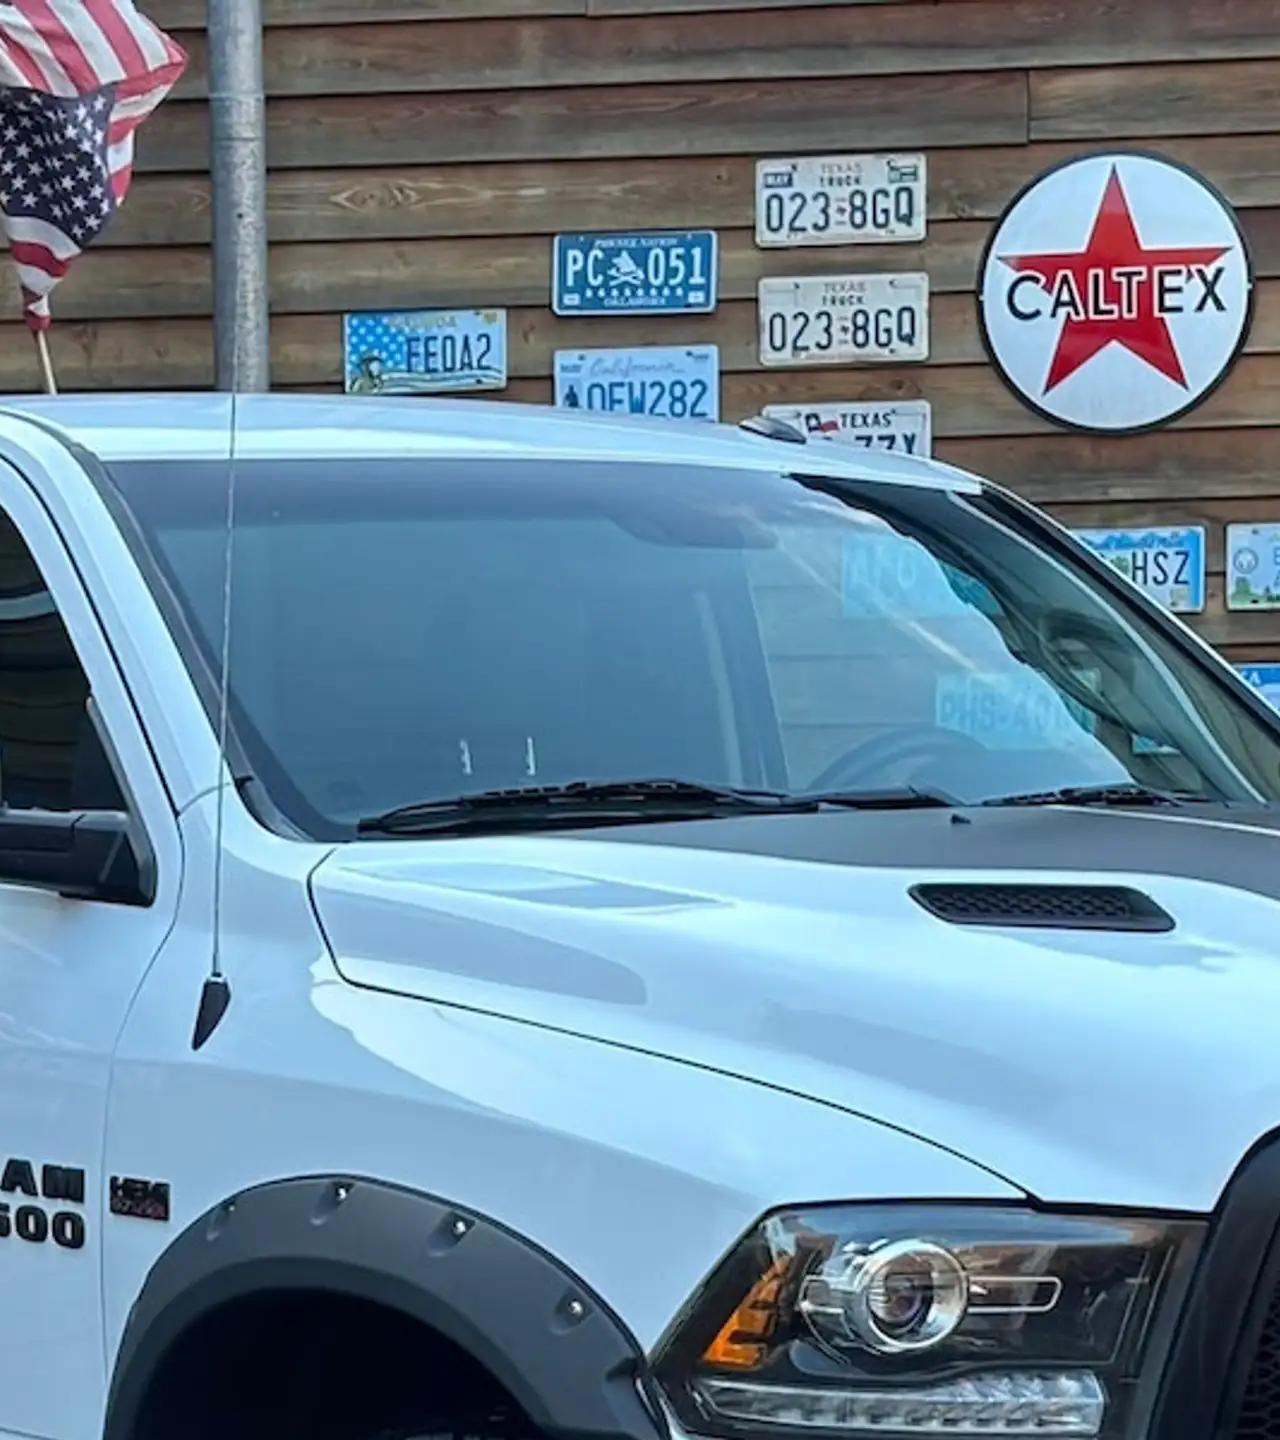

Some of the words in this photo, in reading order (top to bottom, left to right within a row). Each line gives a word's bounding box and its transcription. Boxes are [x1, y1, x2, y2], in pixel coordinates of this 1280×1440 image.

[820, 175, 861, 187] TRUCK
[566, 249, 604, 286] PC
[647, 246, 706, 286] 051
[822, 295, 864, 306] TRUCK
[1007, 266, 1228, 320] CALTEX
[839, 412, 892, 429] TEXAS
[1131, 551, 1190, 585] HSZ
